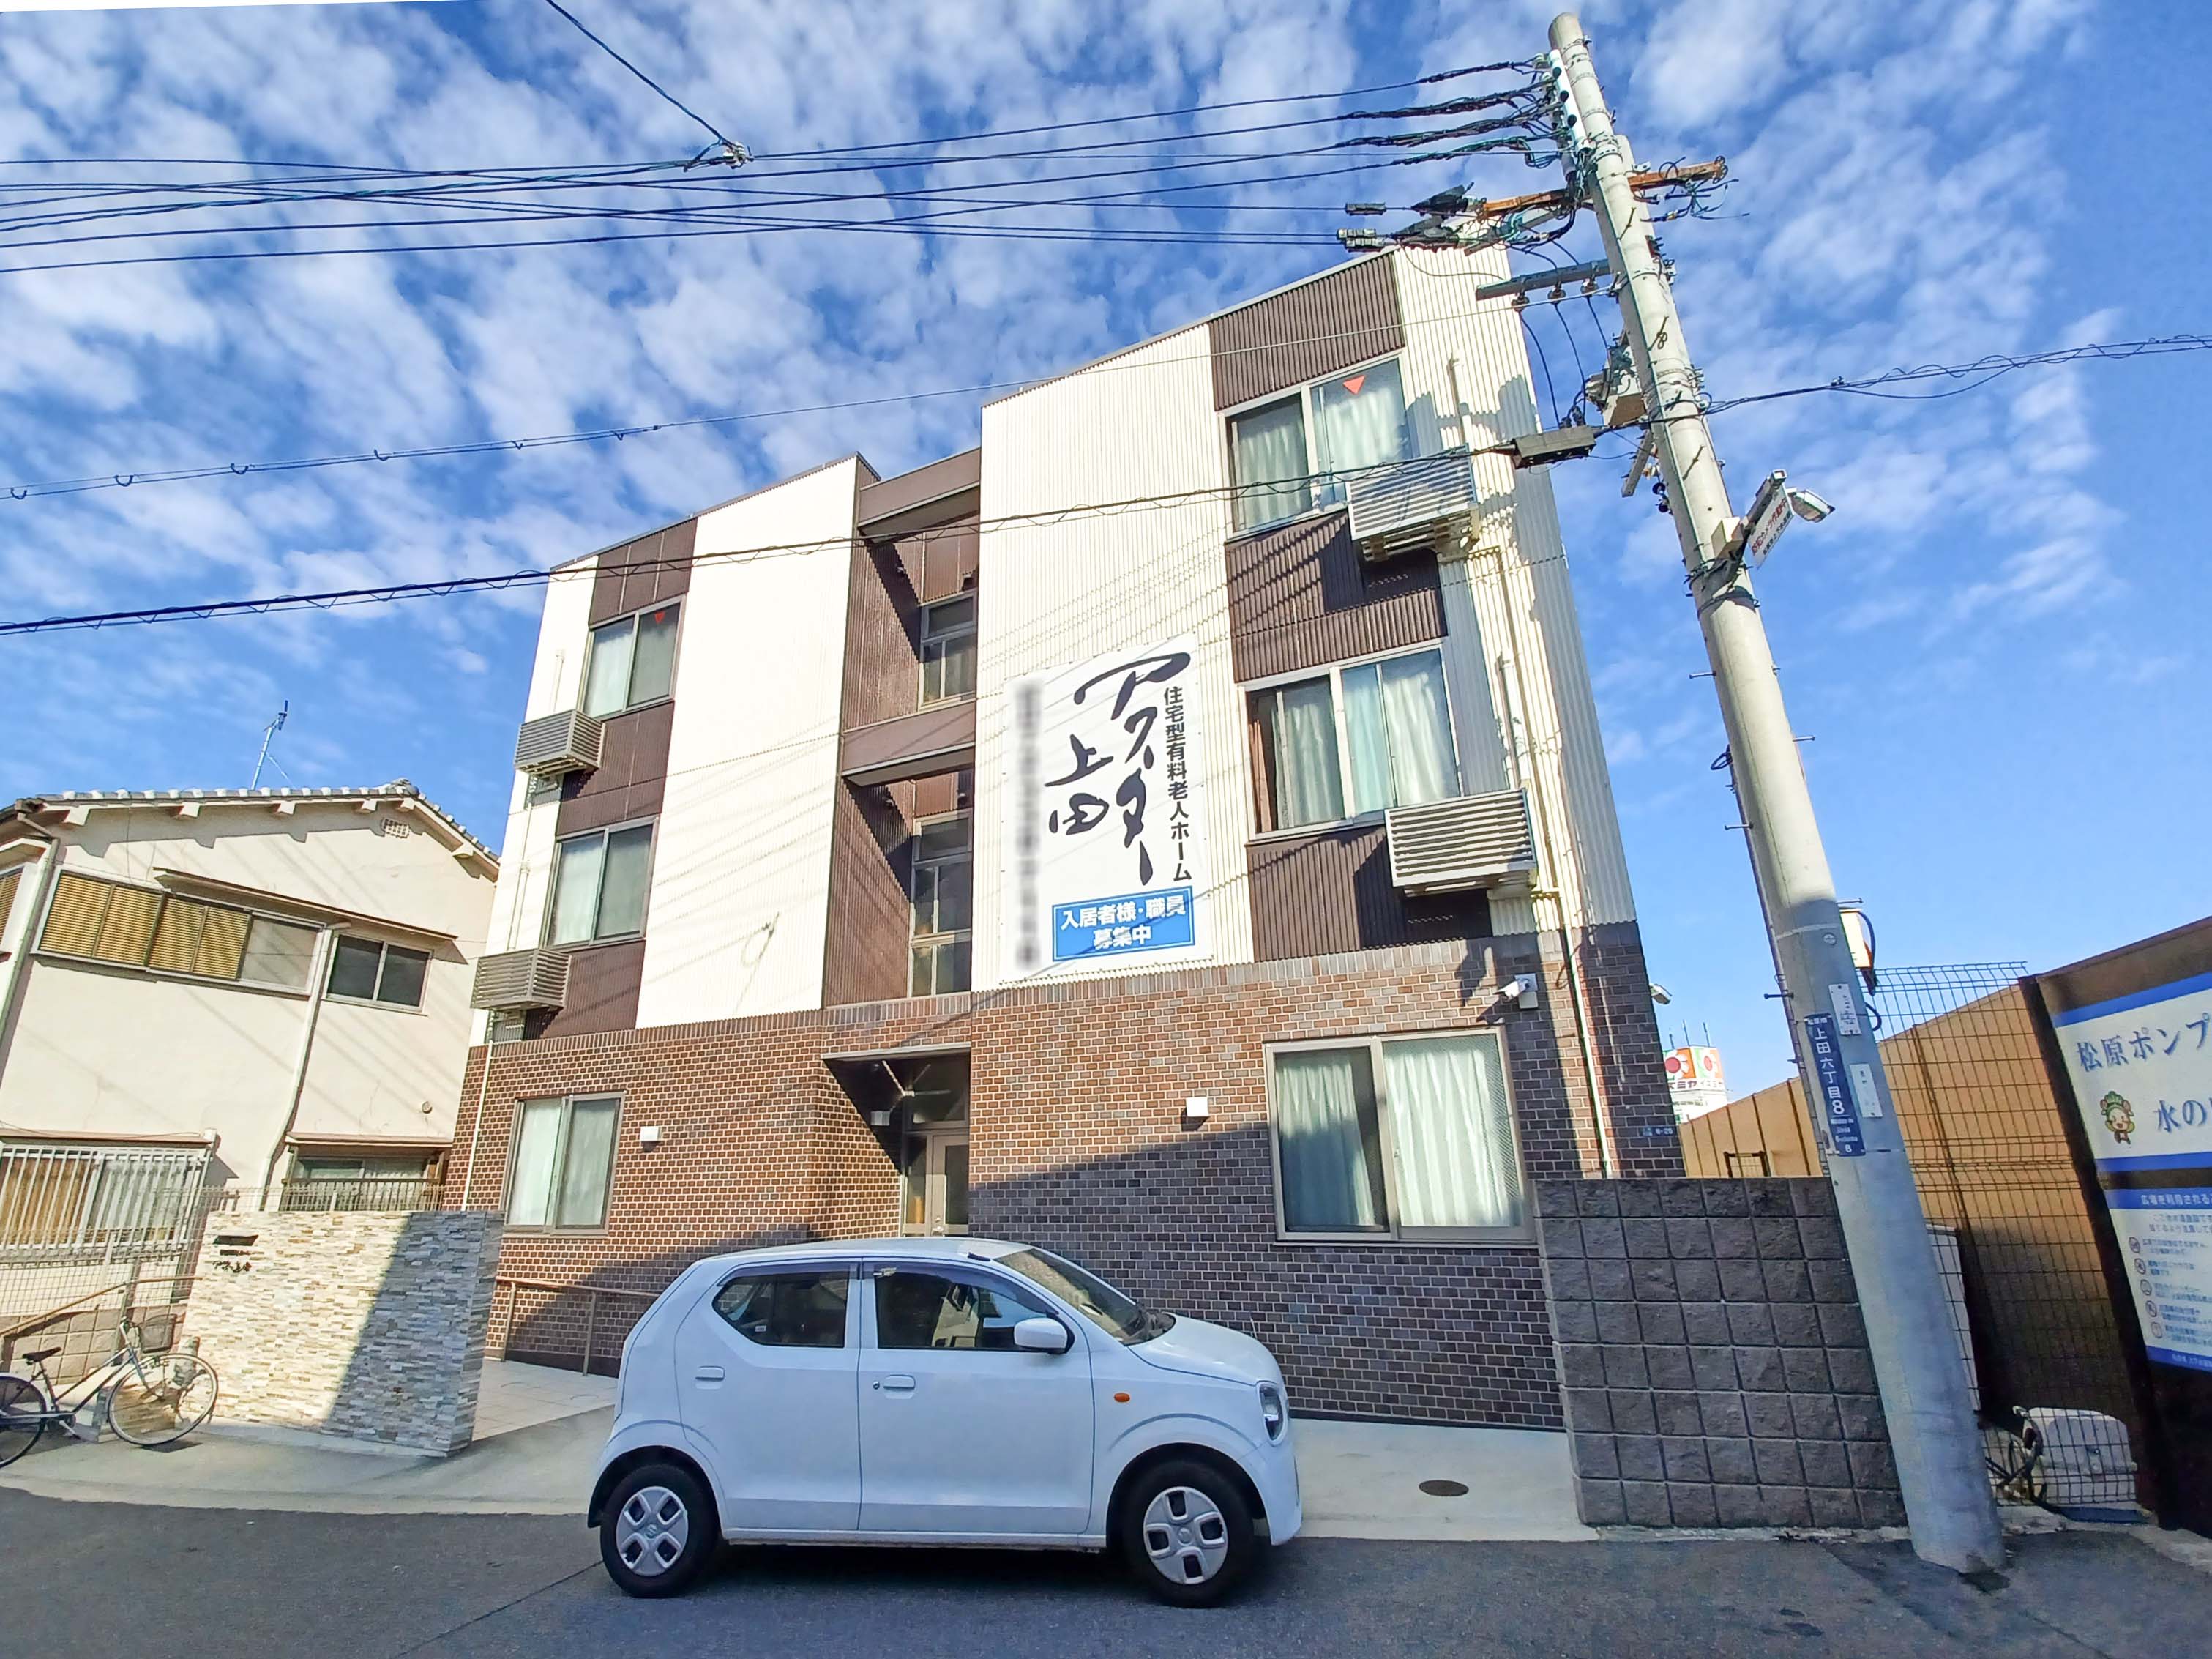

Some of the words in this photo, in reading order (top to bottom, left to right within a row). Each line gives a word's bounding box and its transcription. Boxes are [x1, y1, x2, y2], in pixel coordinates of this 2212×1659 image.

[1045, 734, 1113, 835] 上田
[1164, 686, 1192, 882] 住宅型有料老人ホーム
[1060, 894, 1187, 931] 入居者様・職員
[1093, 925, 1152, 950] 募集中
[2153, 1098, 2212, 1133] 水の
